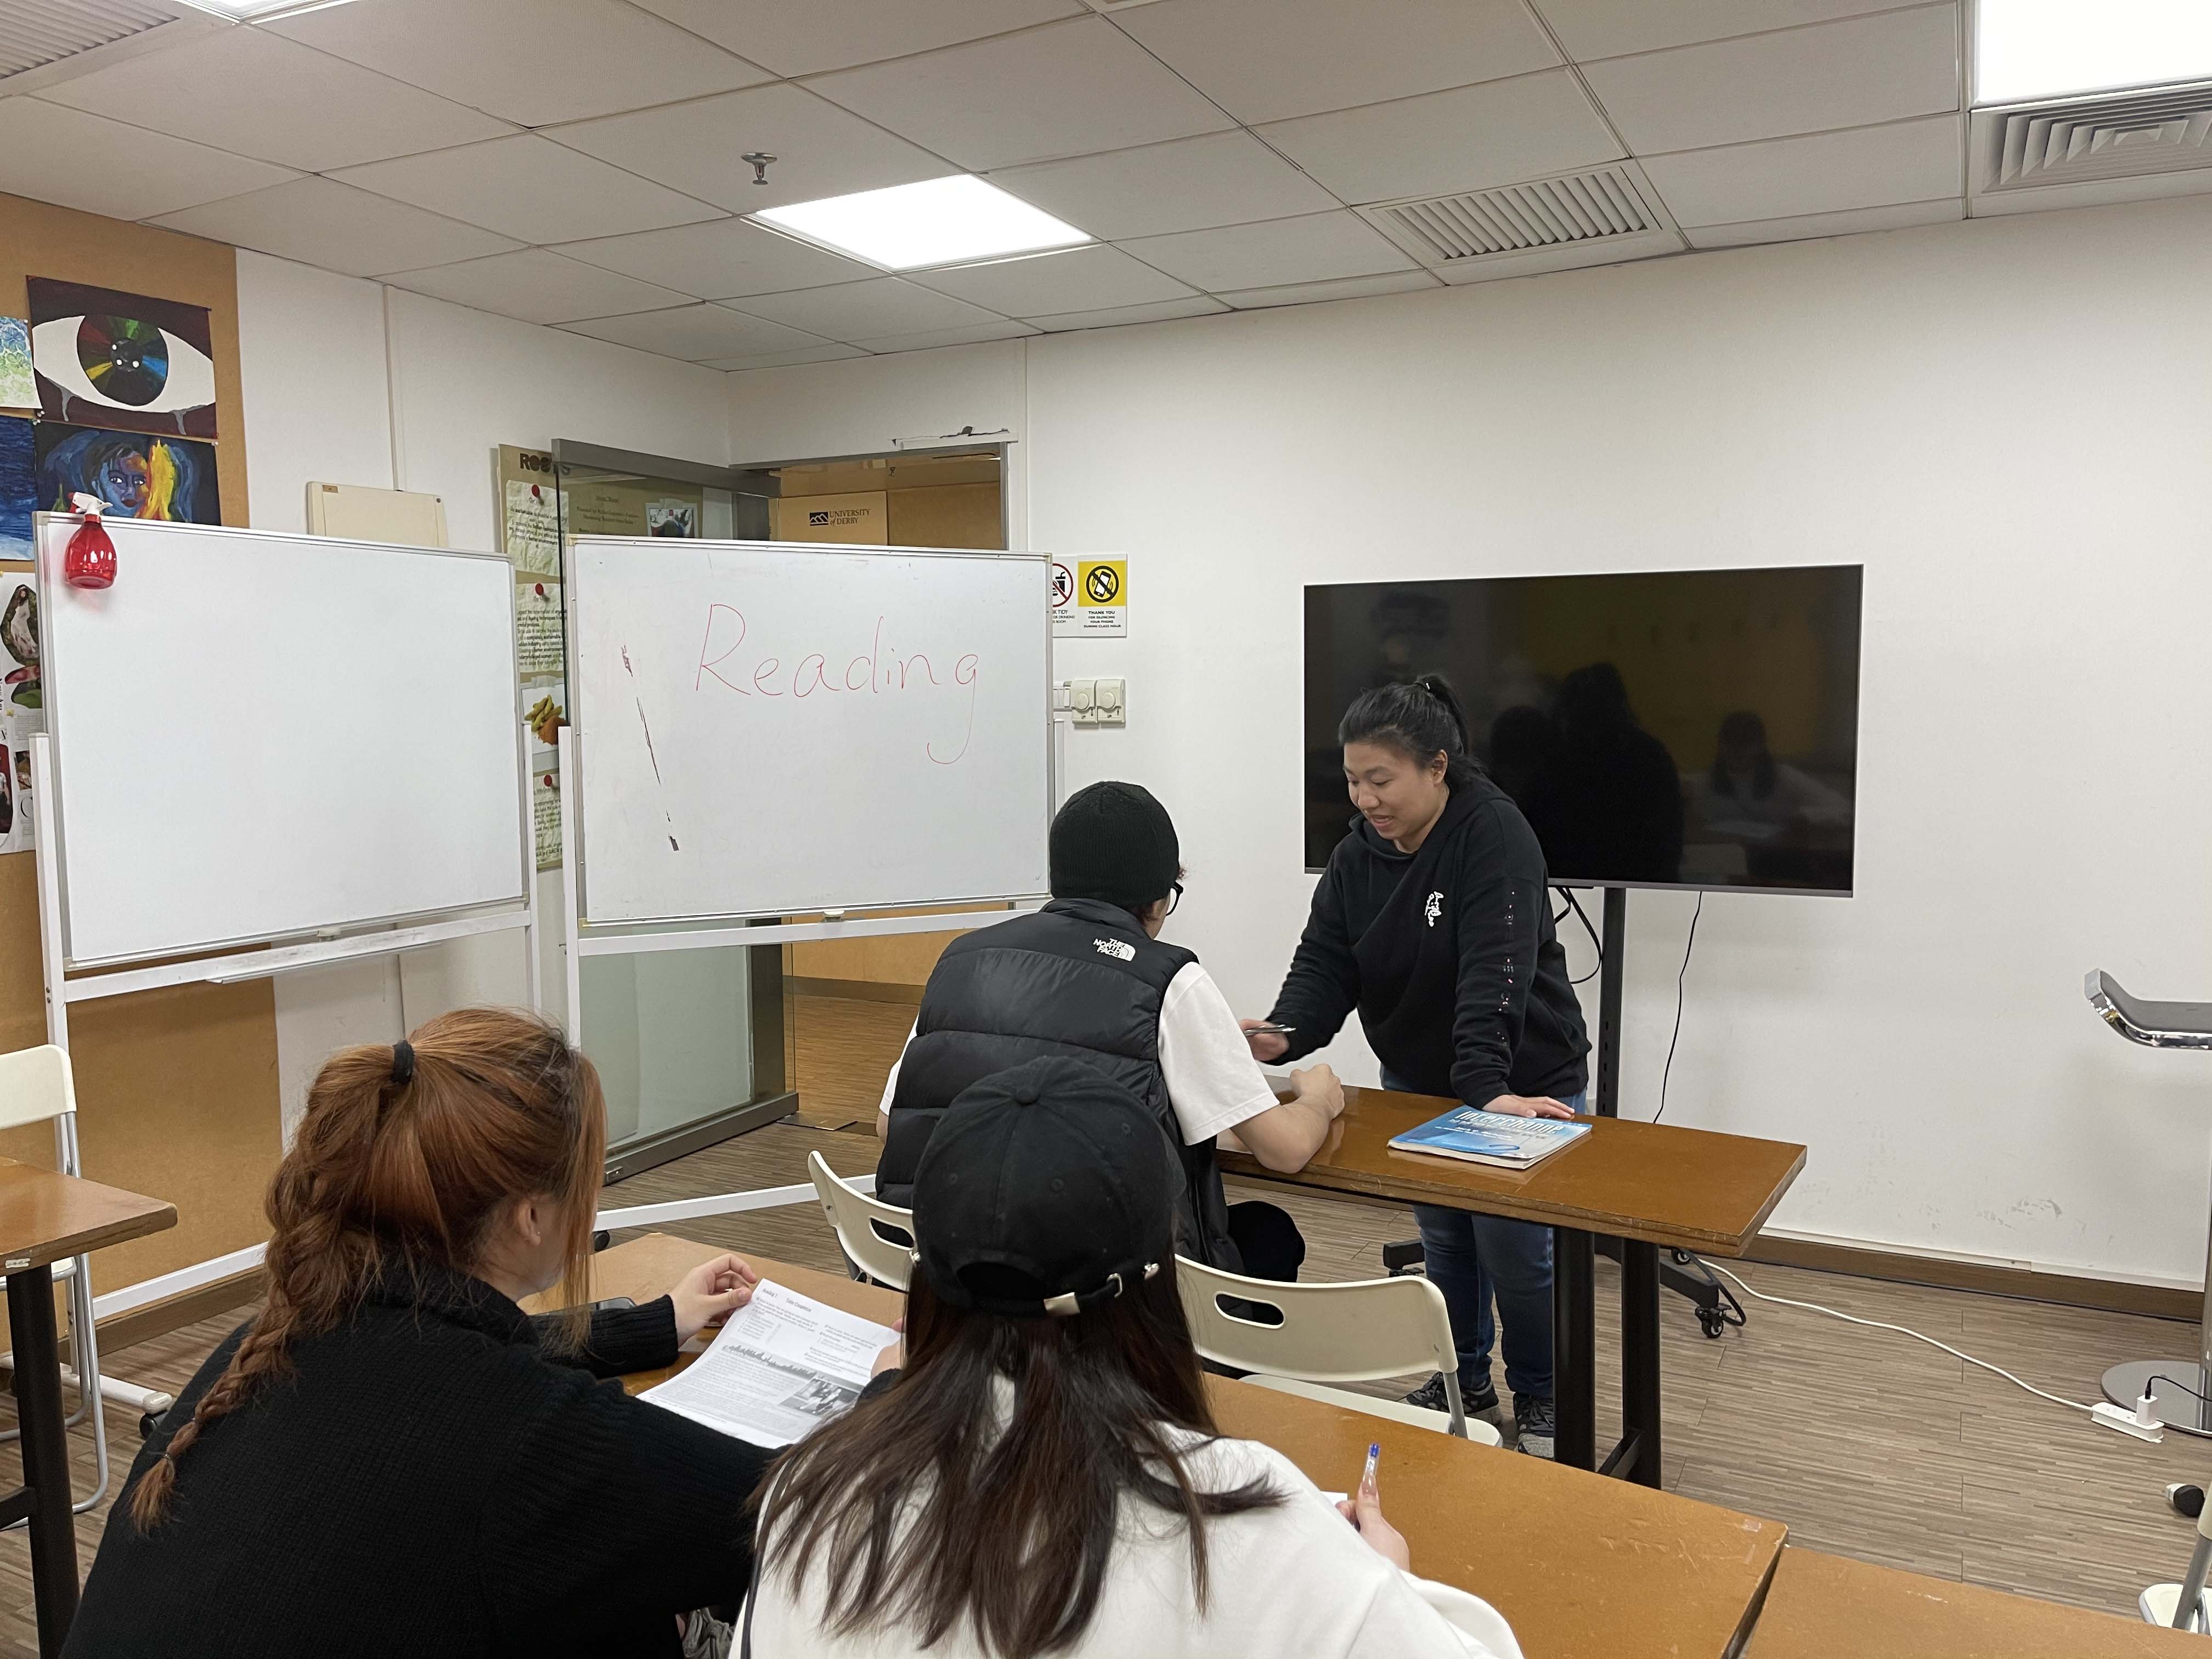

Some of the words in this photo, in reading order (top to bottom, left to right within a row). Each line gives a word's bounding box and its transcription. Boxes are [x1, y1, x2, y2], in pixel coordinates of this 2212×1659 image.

[829, 509, 870, 518] UNIVERSITY
[830, 517, 836, 527] of
[696, 604, 979, 765] Reading
[1093, 939, 1122, 952] NORTH
[1108, 938, 1125, 948] THE
[1097, 946, 1120, 957] FACE
